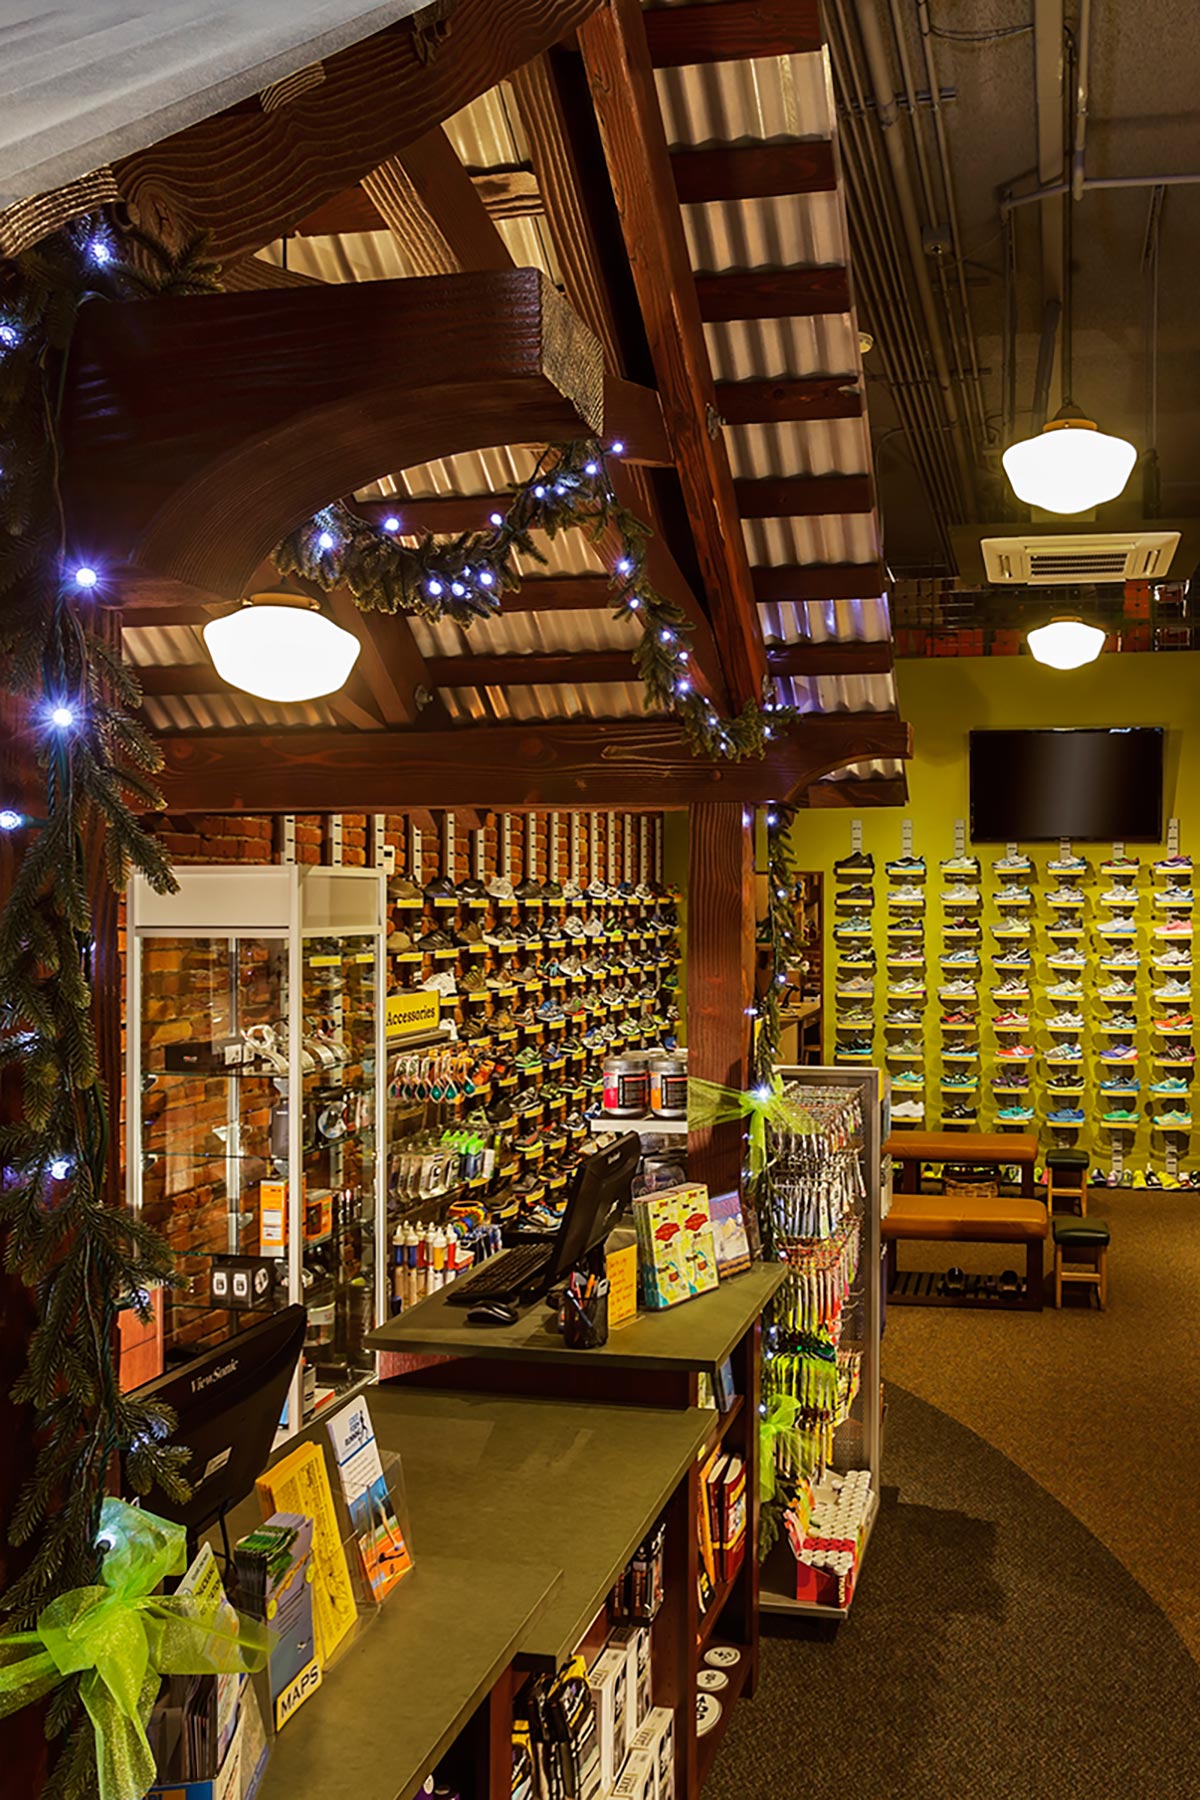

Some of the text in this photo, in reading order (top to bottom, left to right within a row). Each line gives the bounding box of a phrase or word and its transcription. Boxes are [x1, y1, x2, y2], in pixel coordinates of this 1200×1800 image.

[386, 1005, 435, 1026] Accessories
[191, 1358, 239, 1393] ViewSonic
[281, 1665, 319, 1718] MAPS
